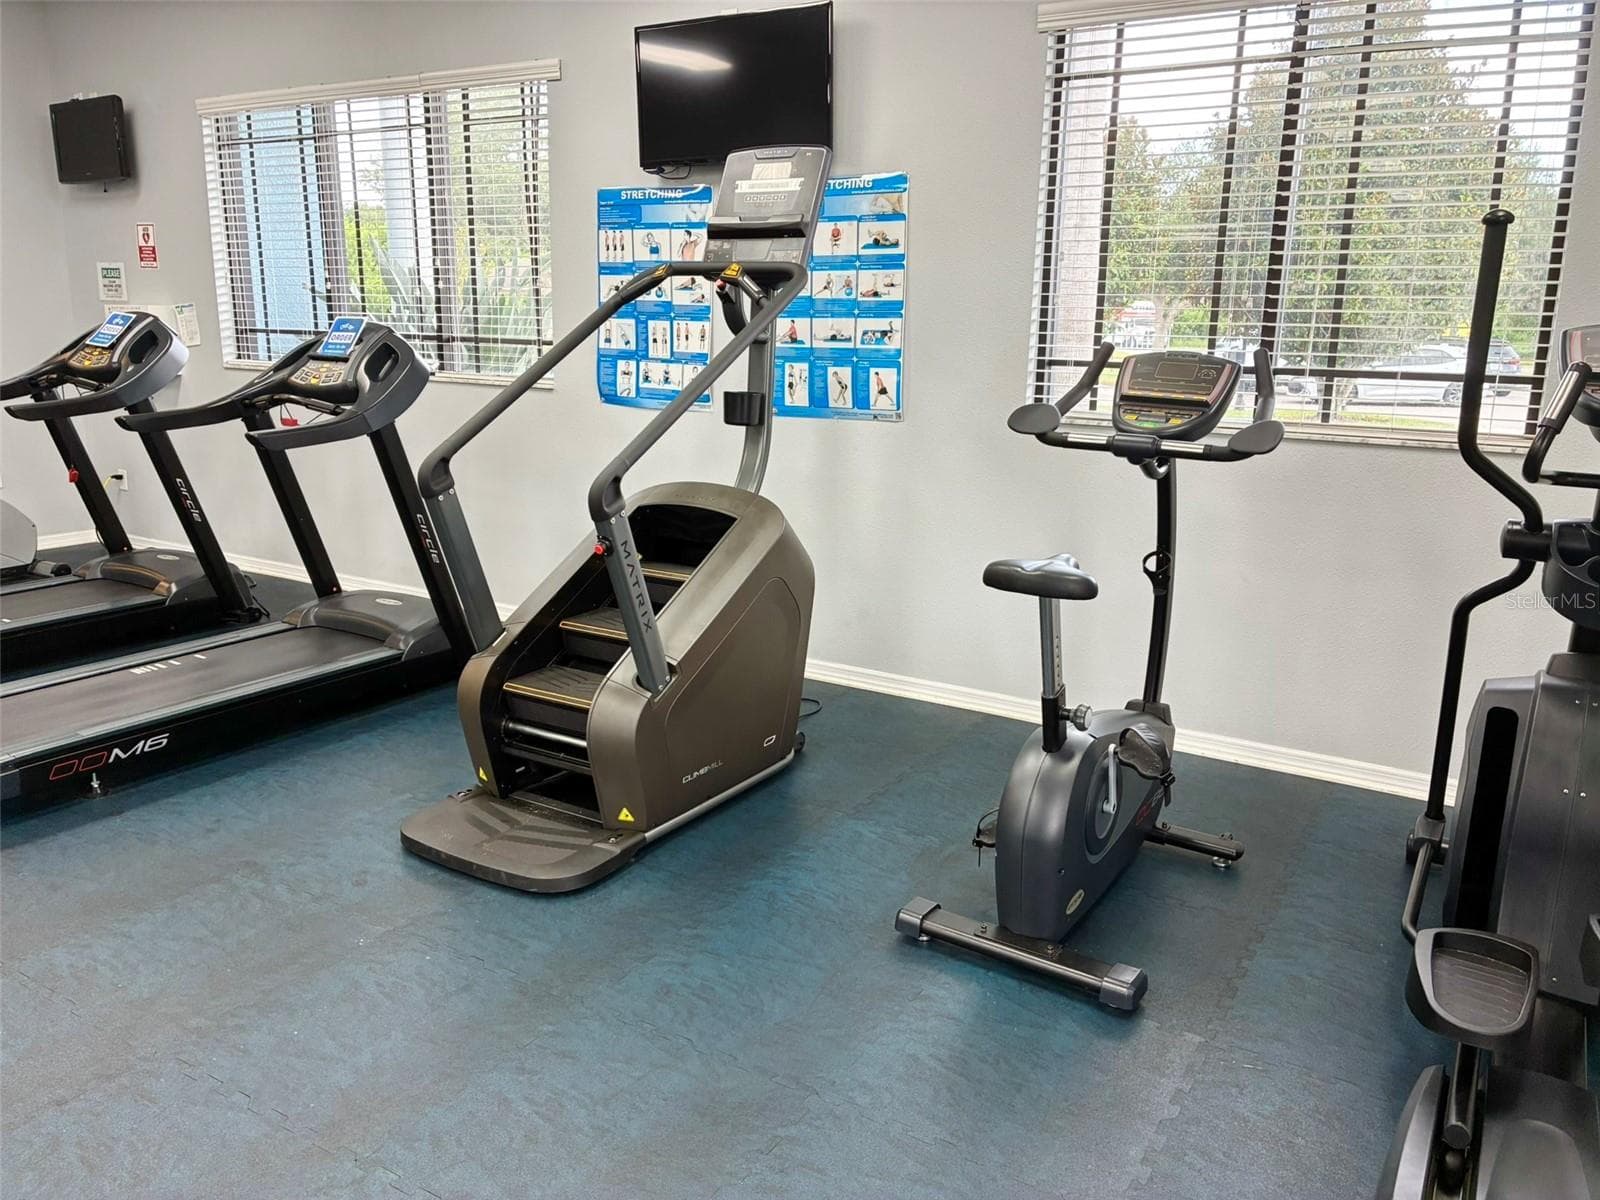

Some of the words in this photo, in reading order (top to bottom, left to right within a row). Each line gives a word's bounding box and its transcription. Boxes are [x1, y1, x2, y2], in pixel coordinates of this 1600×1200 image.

[824, 179, 873, 190] TCHING
[620, 189, 682, 200] STRETCHING
[620, 539, 653, 633] MATRIX
